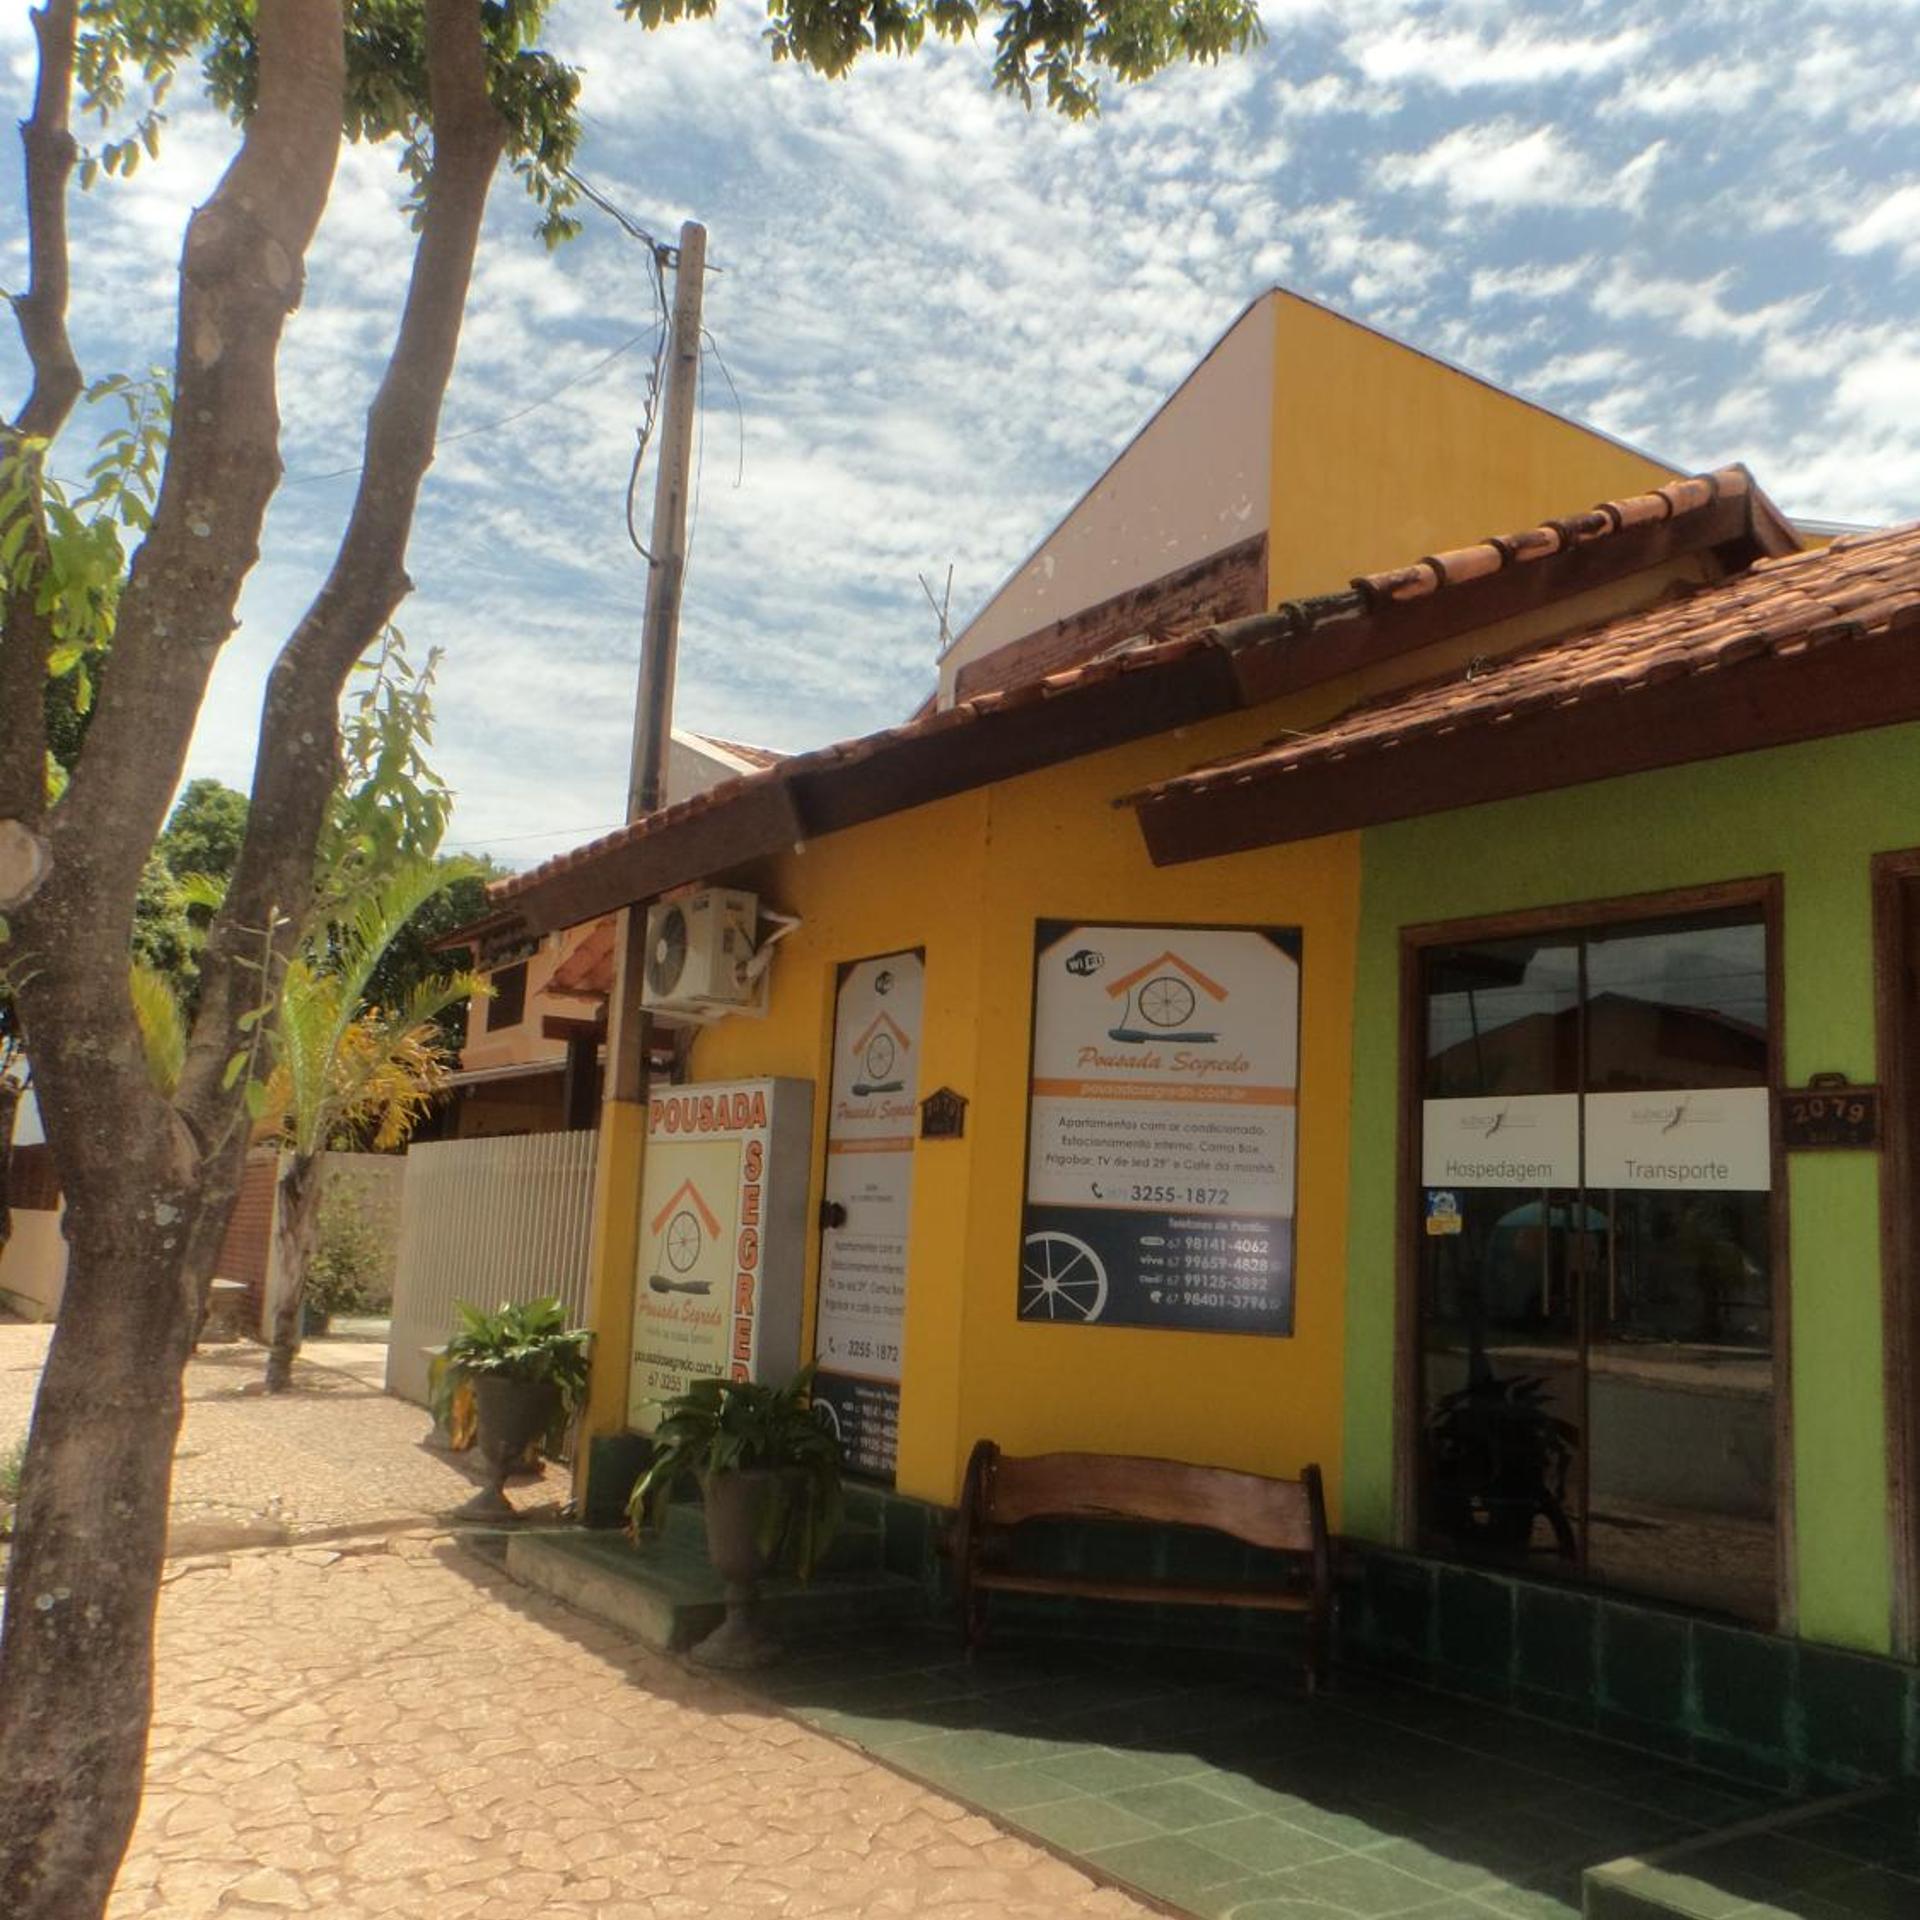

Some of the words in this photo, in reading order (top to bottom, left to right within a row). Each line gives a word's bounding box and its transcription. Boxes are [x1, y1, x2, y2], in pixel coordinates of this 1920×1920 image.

[1077, 1046, 1160, 1069] Pousada
[1170, 1051, 1250, 1077] Segredo
[649, 1091, 767, 1134] POUSADA
[1792, 1098, 1865, 1124] 2079
[1446, 1160, 1552, 1183] Hospedagem
[1625, 1160, 1729, 1183] Transporte
[1131, 1185, 1230, 1205] 3255-1872
[1184, 1236, 1269, 1254] 98141-4062
[731, 1140, 763, 1384] SEGRED
